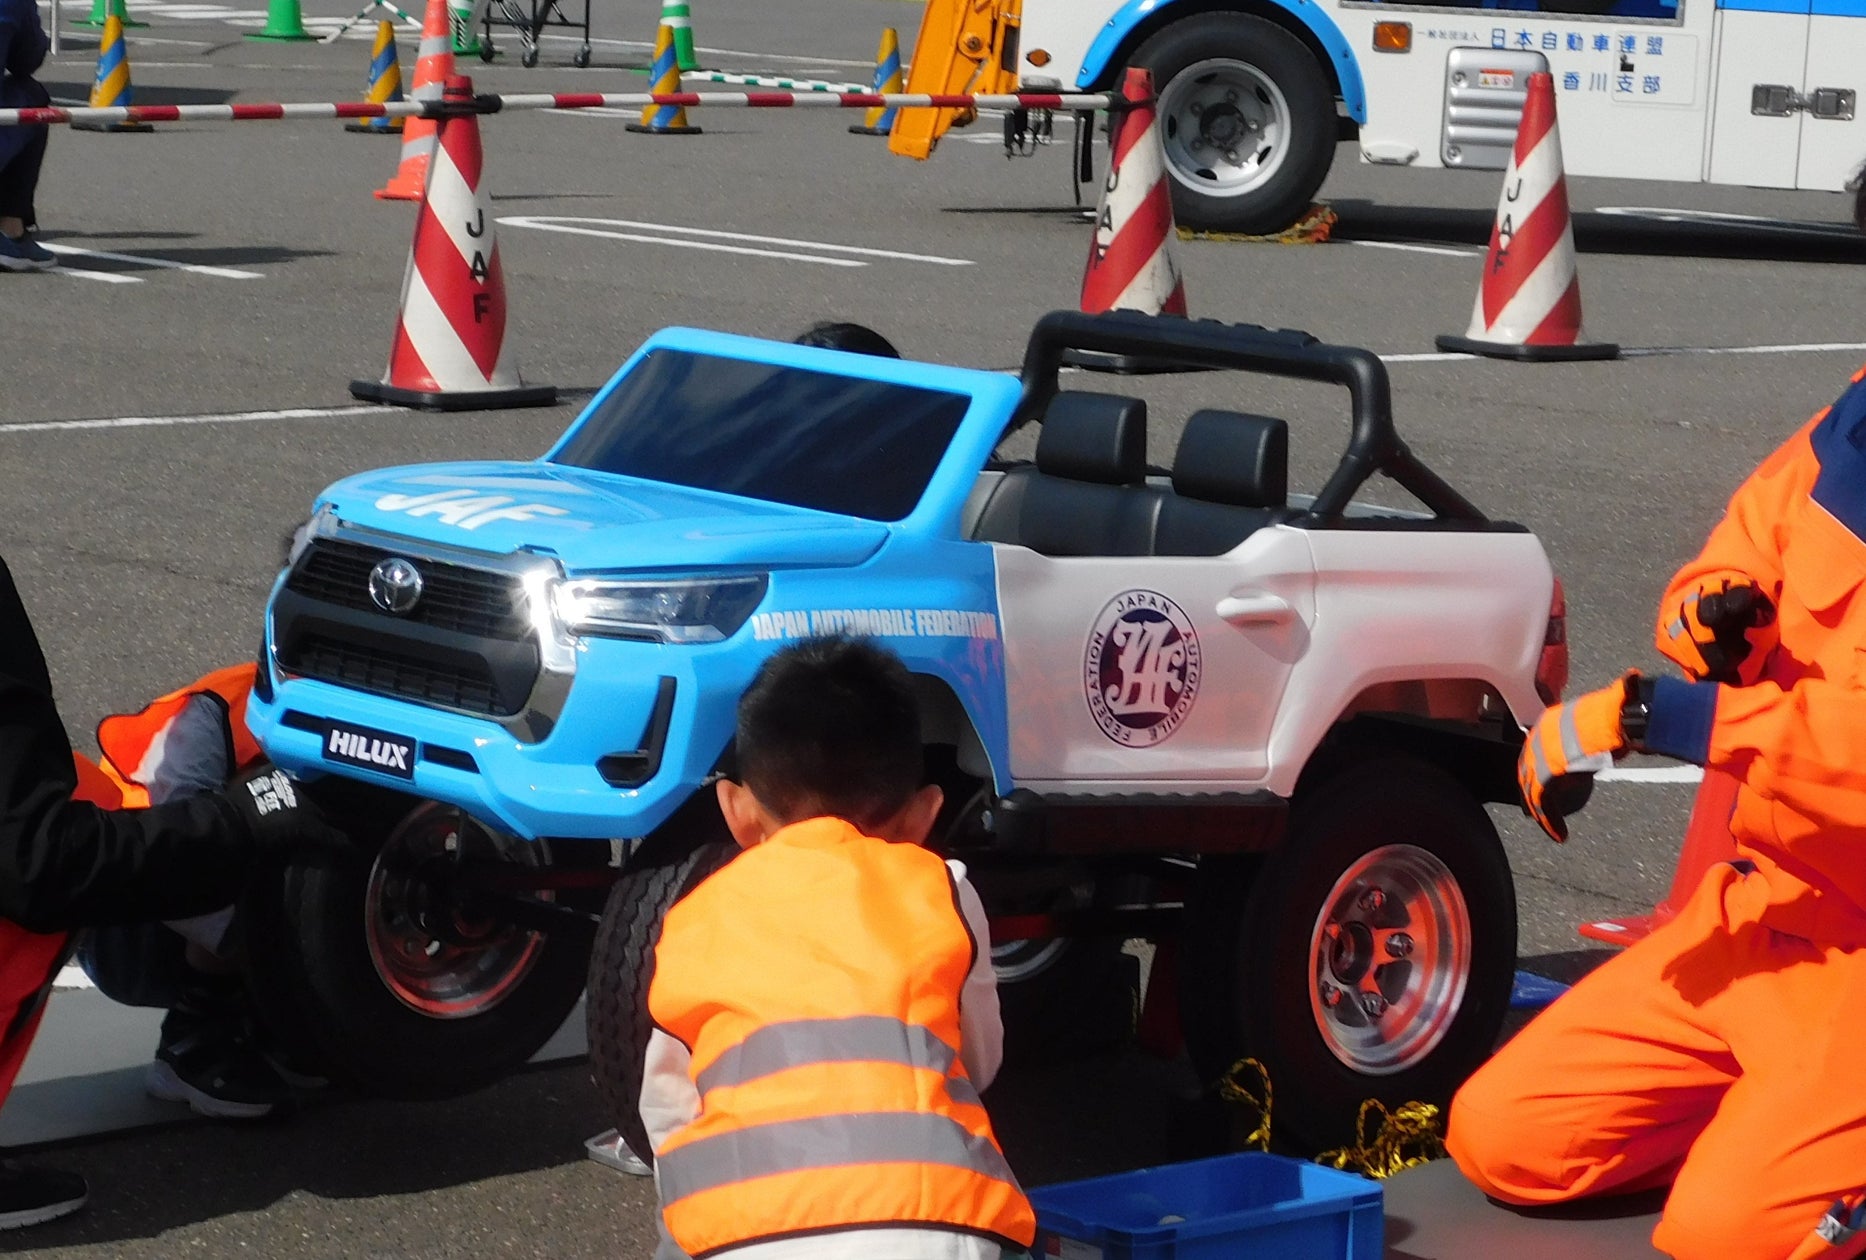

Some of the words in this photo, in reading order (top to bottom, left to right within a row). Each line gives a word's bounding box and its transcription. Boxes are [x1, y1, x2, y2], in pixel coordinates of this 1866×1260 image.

[1563, 71, 1661, 94] 香川支部
[1493, 178, 1522, 274] JAF
[466, 208, 489, 323] JAF
[375, 489, 571, 530] JAF
[752, 610, 810, 641] JAPAN
[811, 608, 915, 637] AUTOMOBILE
[914, 609, 997, 640] FEDERATION
[1116, 594, 1171, 614] JAPAN
[1087, 631, 1132, 742] FEDERATION
[1148, 631, 1198, 741] AUTOMOBILE
[328, 729, 409, 770] HILUX
